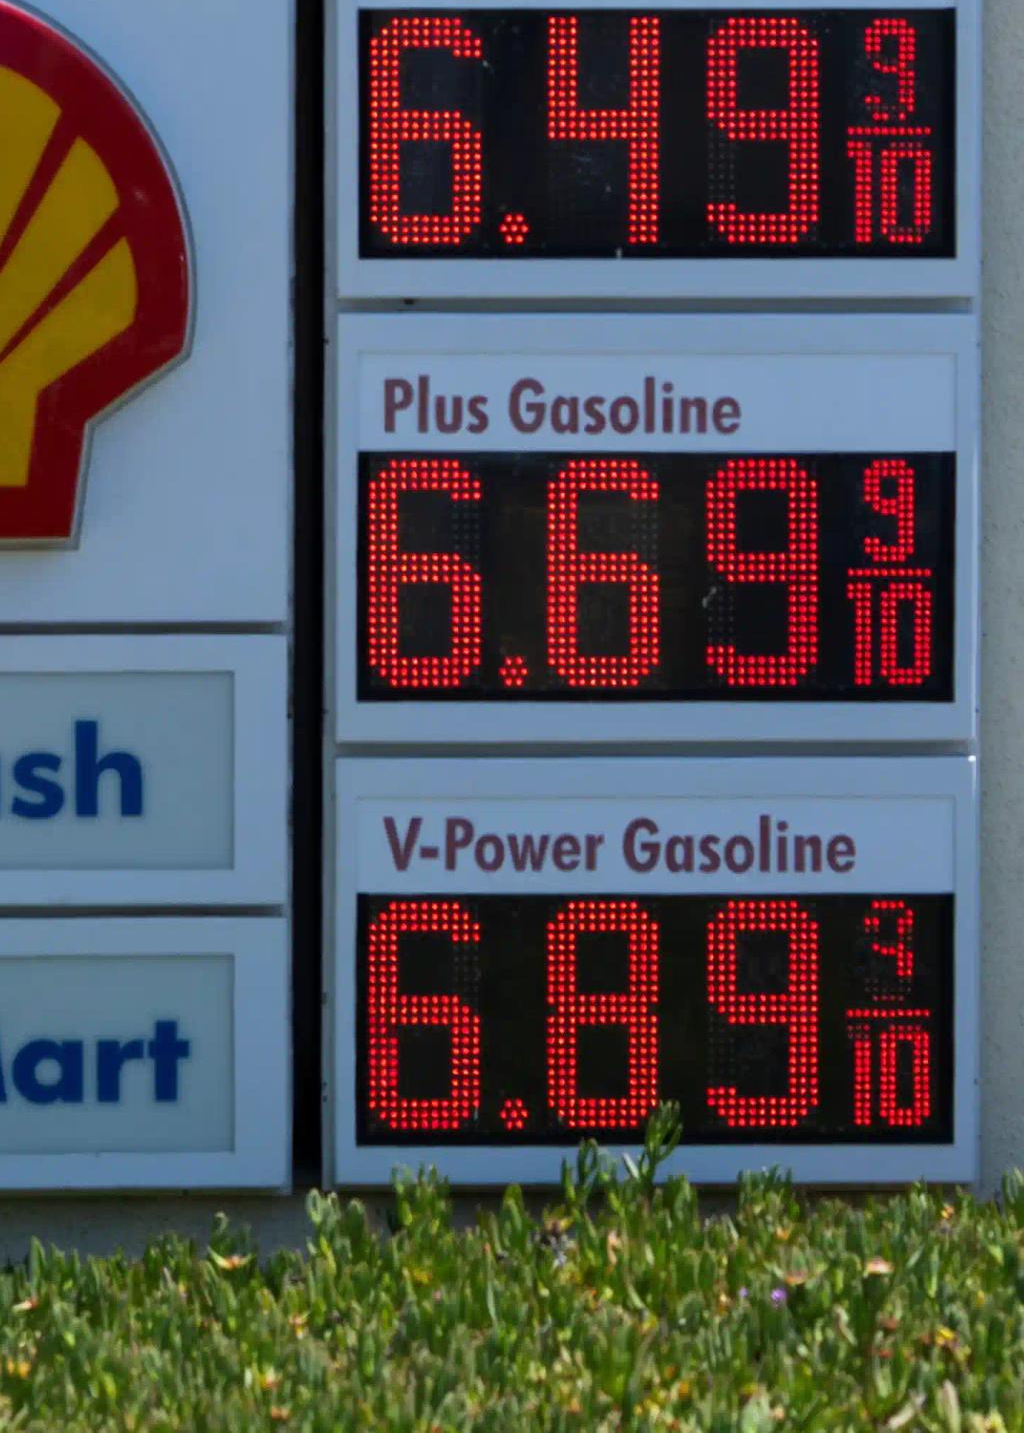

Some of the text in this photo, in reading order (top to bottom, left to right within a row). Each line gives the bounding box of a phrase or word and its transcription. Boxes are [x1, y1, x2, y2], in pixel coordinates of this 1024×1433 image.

[383, 374, 742, 437] Plus Gasoline
[383, 815, 857, 876] V-Power Gasoline
